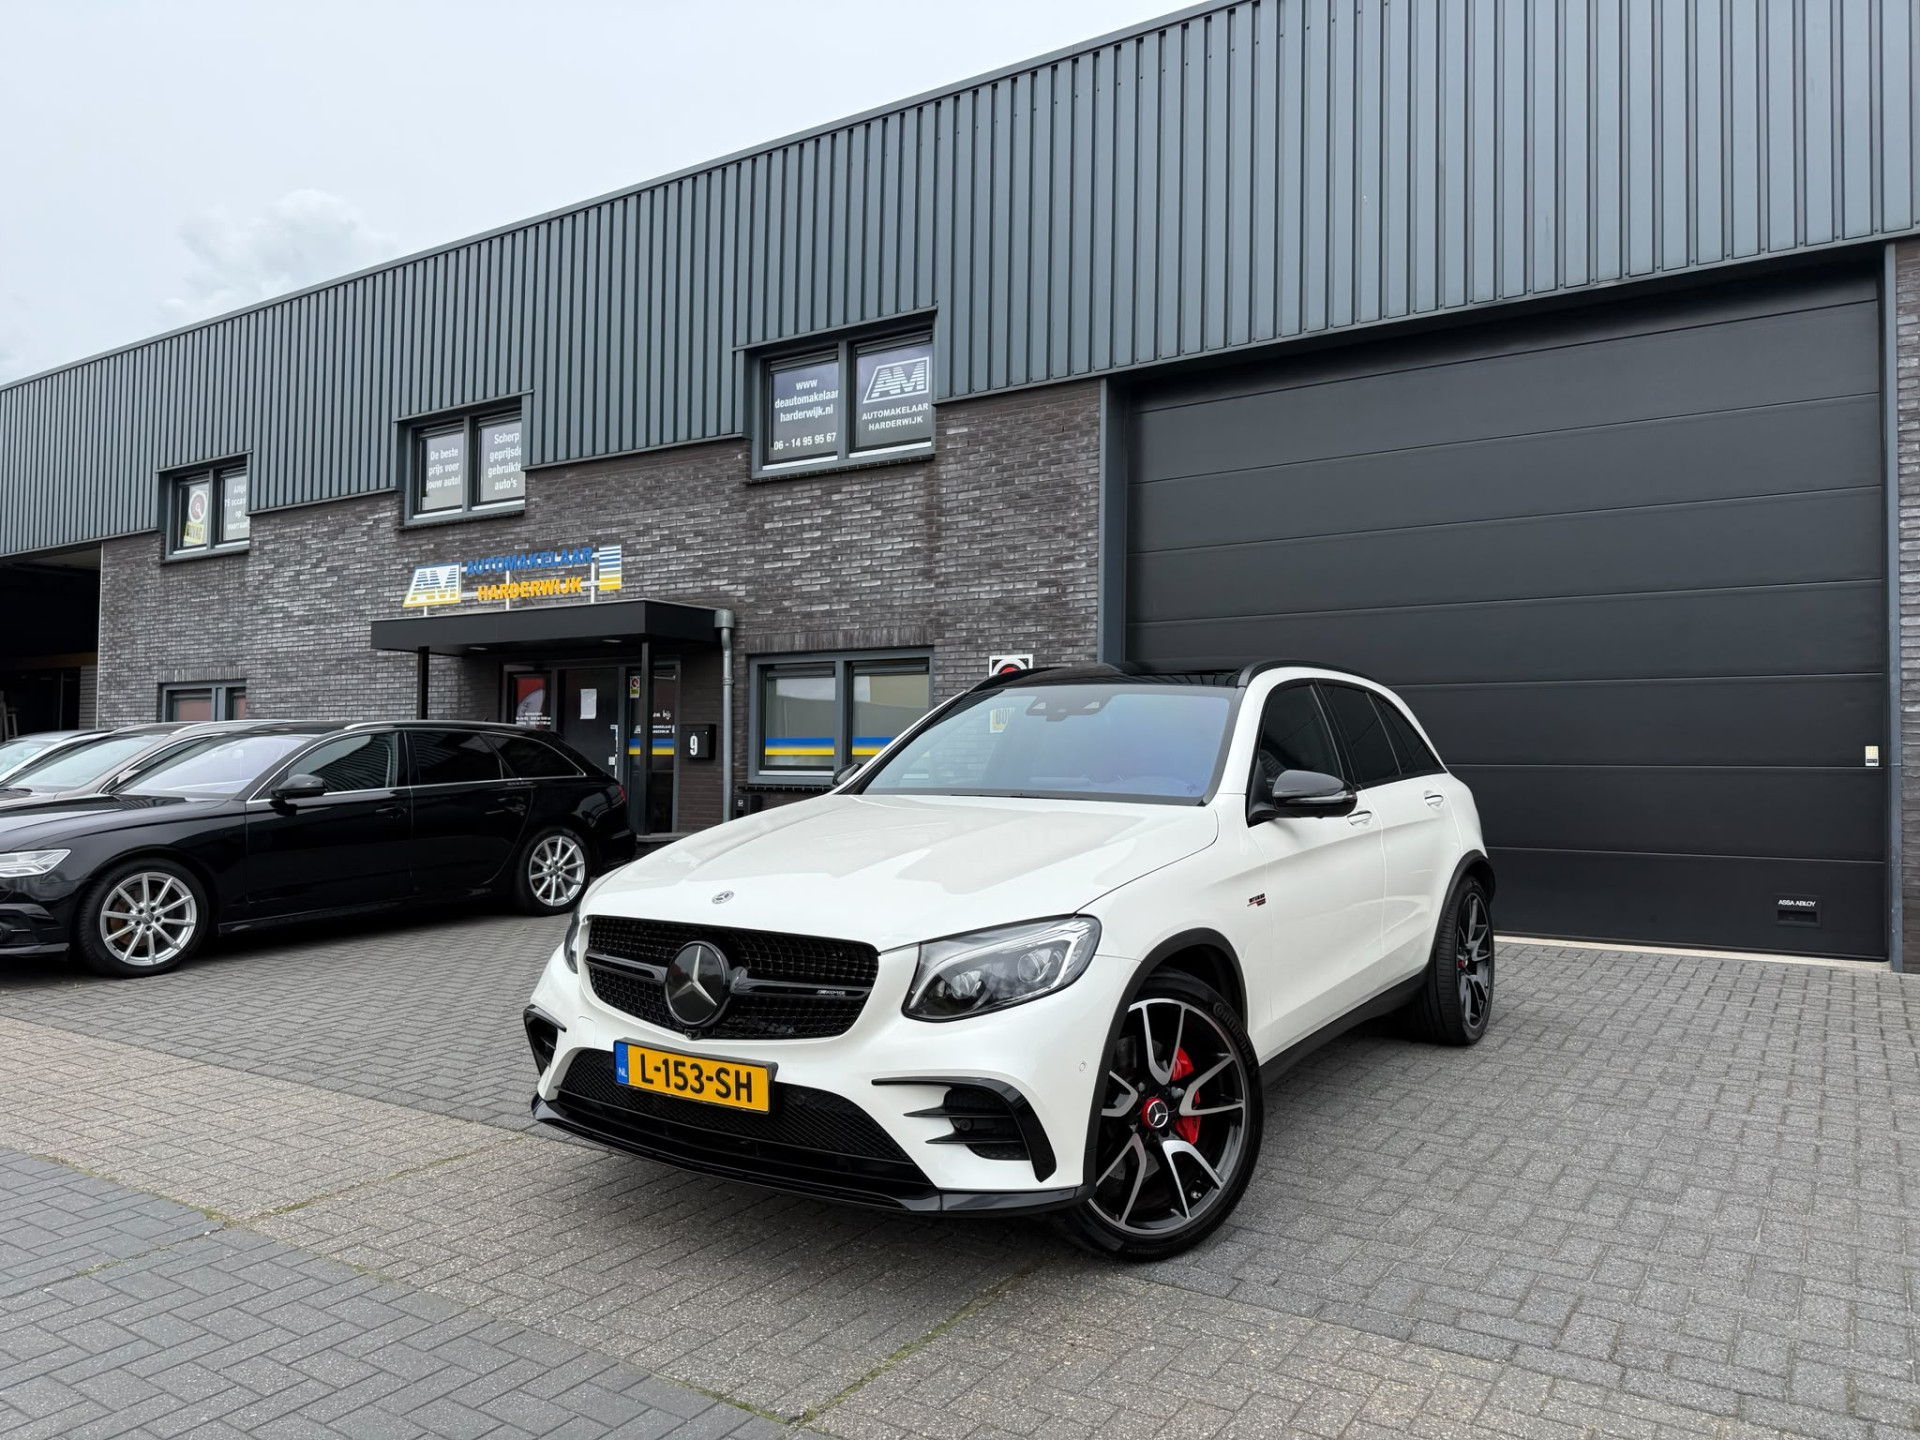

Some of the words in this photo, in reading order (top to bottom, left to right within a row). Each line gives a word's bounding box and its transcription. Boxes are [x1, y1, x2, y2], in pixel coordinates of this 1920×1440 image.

[796, 379, 818, 389] www
[775, 390, 838, 409] deautomakelaar
[780, 404, 833, 422] harderwijk.nl
[862, 403, 928, 420] AUTOMAKELAAR
[869, 416, 923, 430] HARDERWIJK
[494, 432, 519, 444] Scherp
[774, 440, 783, 450] 06
[791, 438, 800, 448] 14
[802, 436, 812, 446] 95
[814, 434, 824, 445] 95
[826, 432, 836, 442] 67
[430, 451, 439, 460] De
[440, 448, 459, 459] beste
[429, 465, 443, 477] prijs
[445, 463, 459, 472] voor
[494, 478, 517, 490] auto's
[465, 547, 593, 576] AUTOMAKELAAR
[477, 576, 583, 601] HARDERWIJK
[690, 735, 698, 756] 9
[618, 1067, 628, 1078] NL
[640, 1053, 753, 1104] L-153-SH
